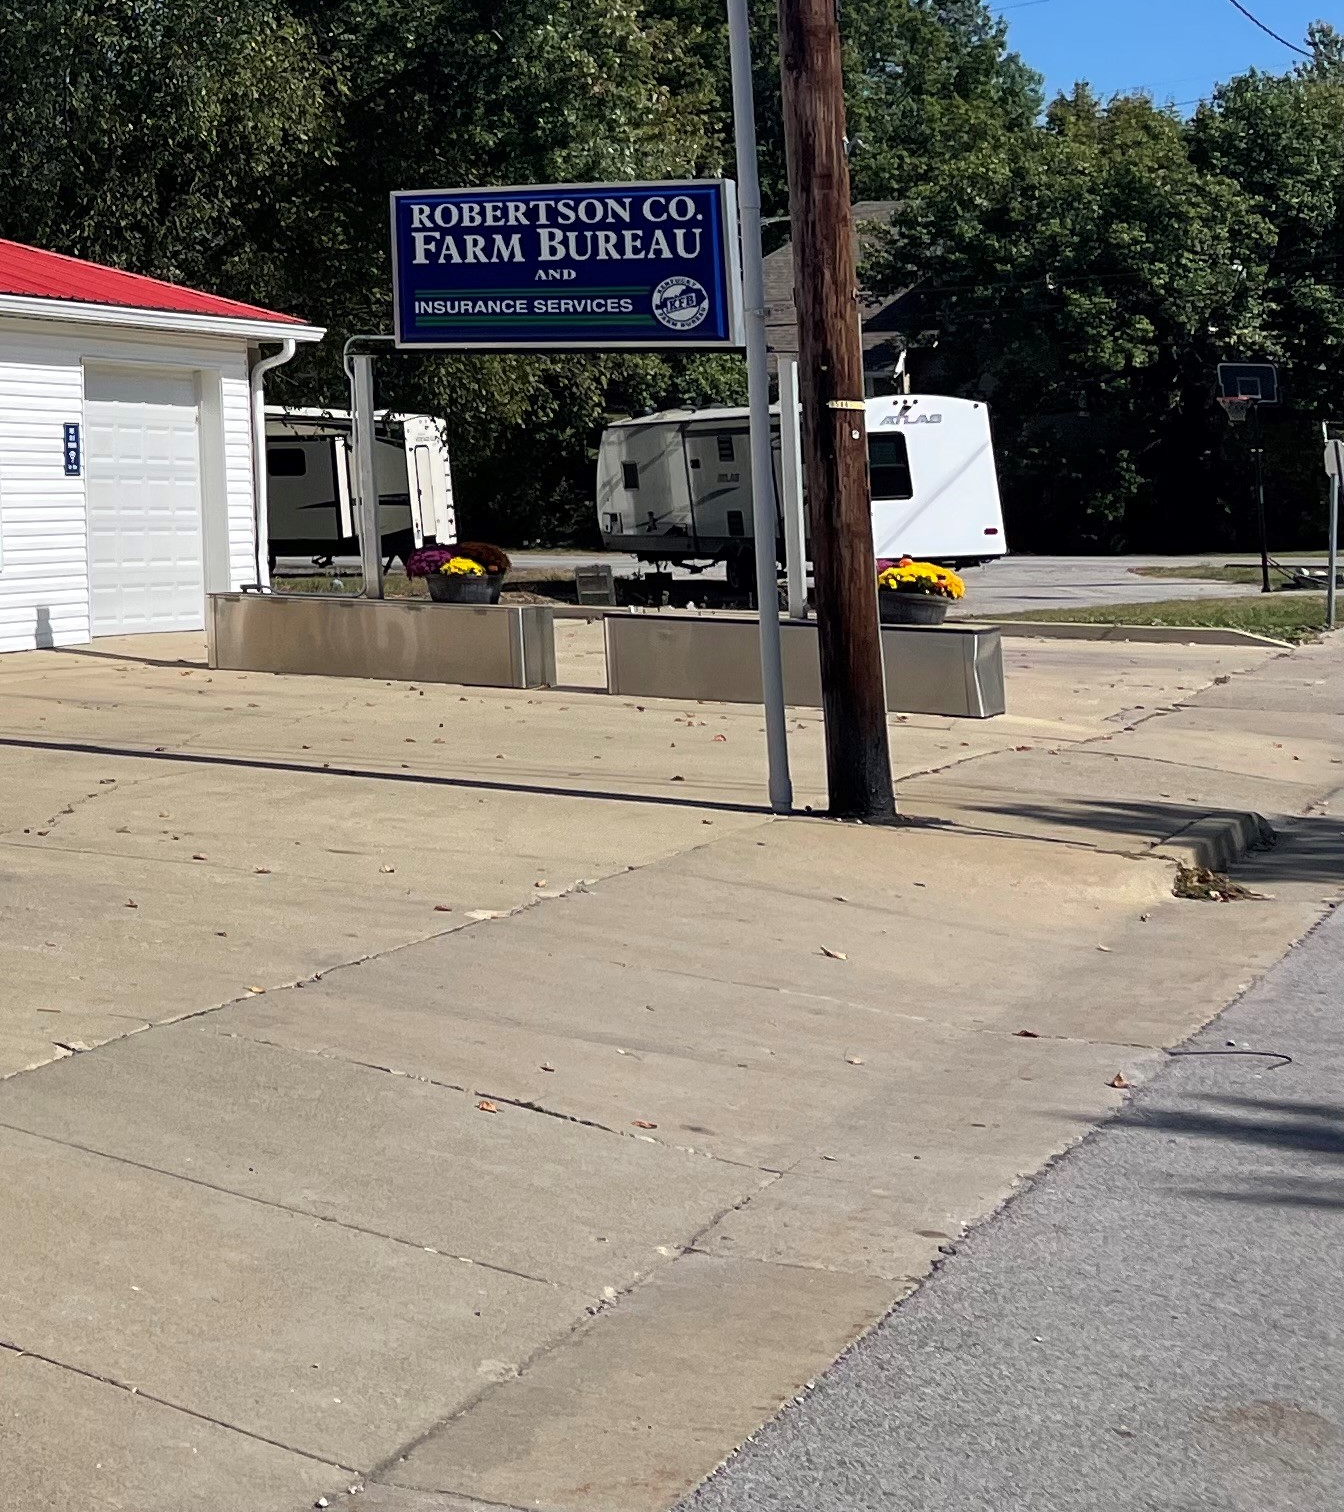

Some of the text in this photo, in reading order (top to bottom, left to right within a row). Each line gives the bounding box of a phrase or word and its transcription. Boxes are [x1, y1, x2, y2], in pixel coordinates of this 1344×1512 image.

[410, 196, 703, 228] ROBERTSON CO.
[411, 228, 702, 264] FARM BUREAU
[534, 269, 576, 280] AND
[415, 299, 633, 314] INSURANCE SERVICES
[669, 295, 693, 311] KFB
